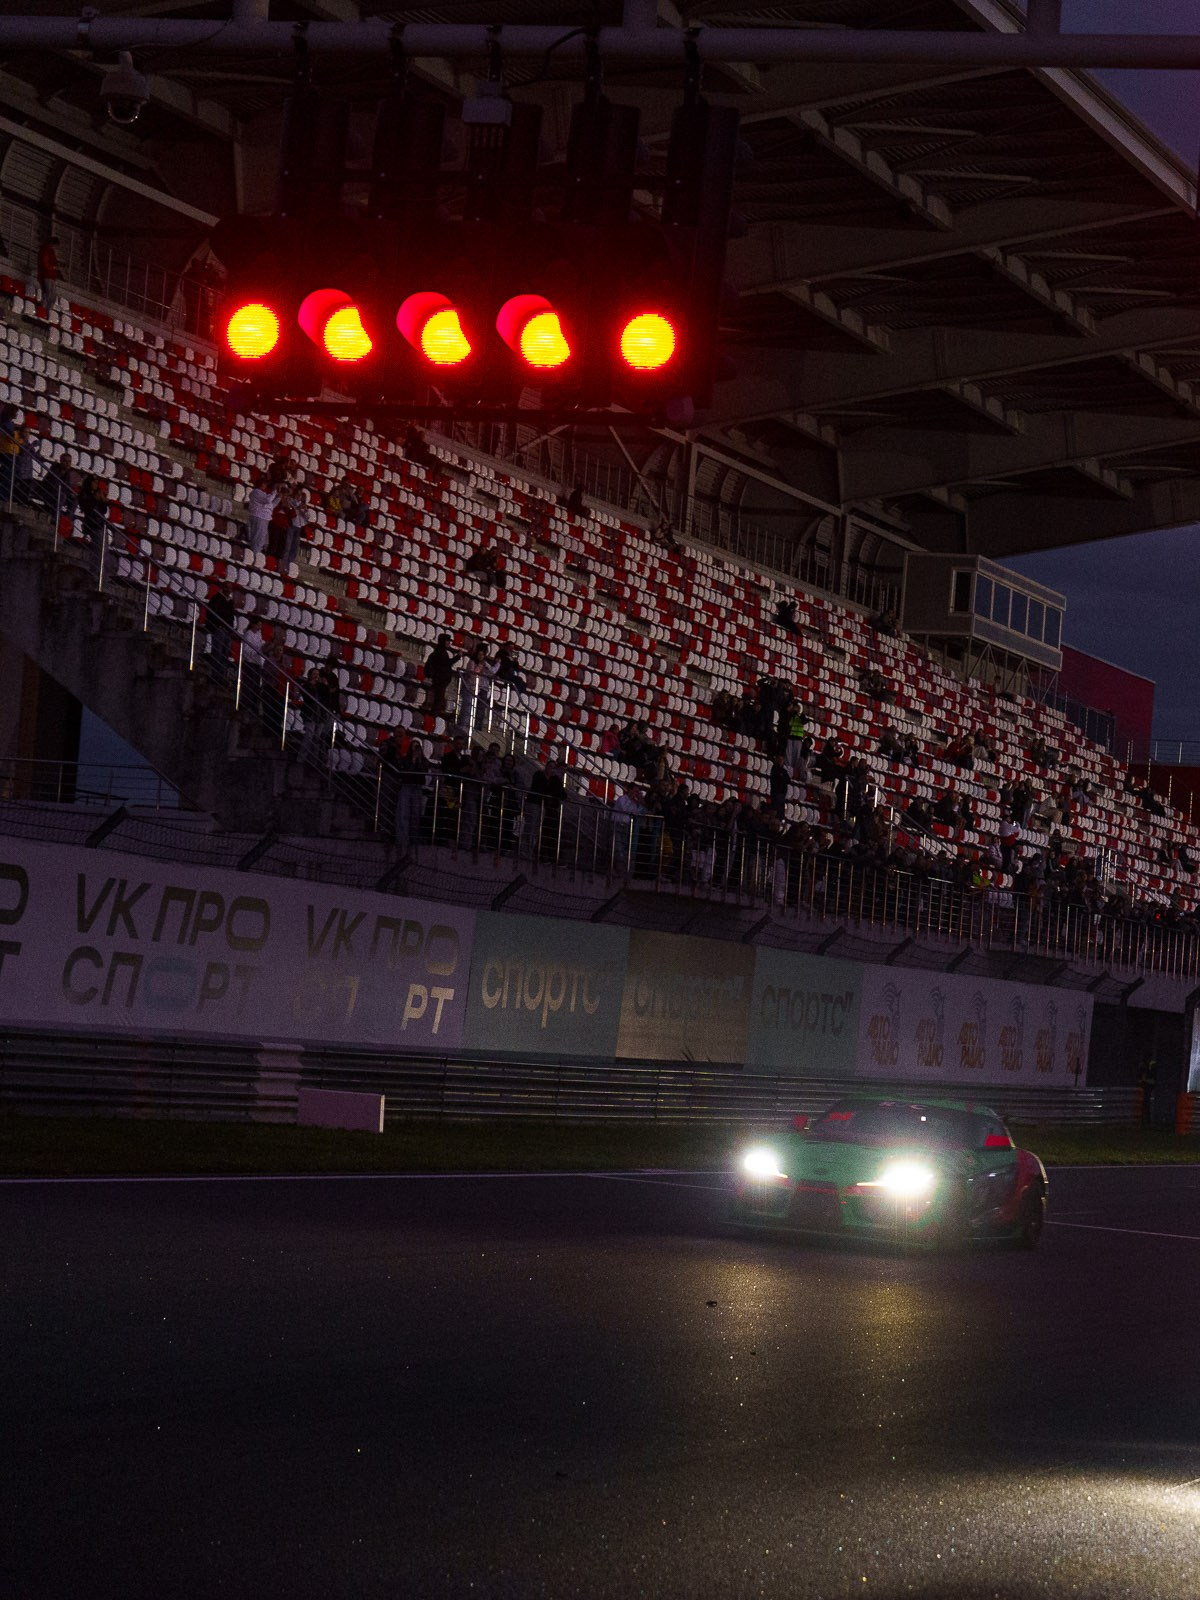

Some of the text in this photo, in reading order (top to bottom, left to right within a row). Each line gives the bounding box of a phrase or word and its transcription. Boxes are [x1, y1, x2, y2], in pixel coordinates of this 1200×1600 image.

[77, 872, 152, 939] VK
[152, 886, 271, 951] ПРО
[306, 904, 368, 960] VK
